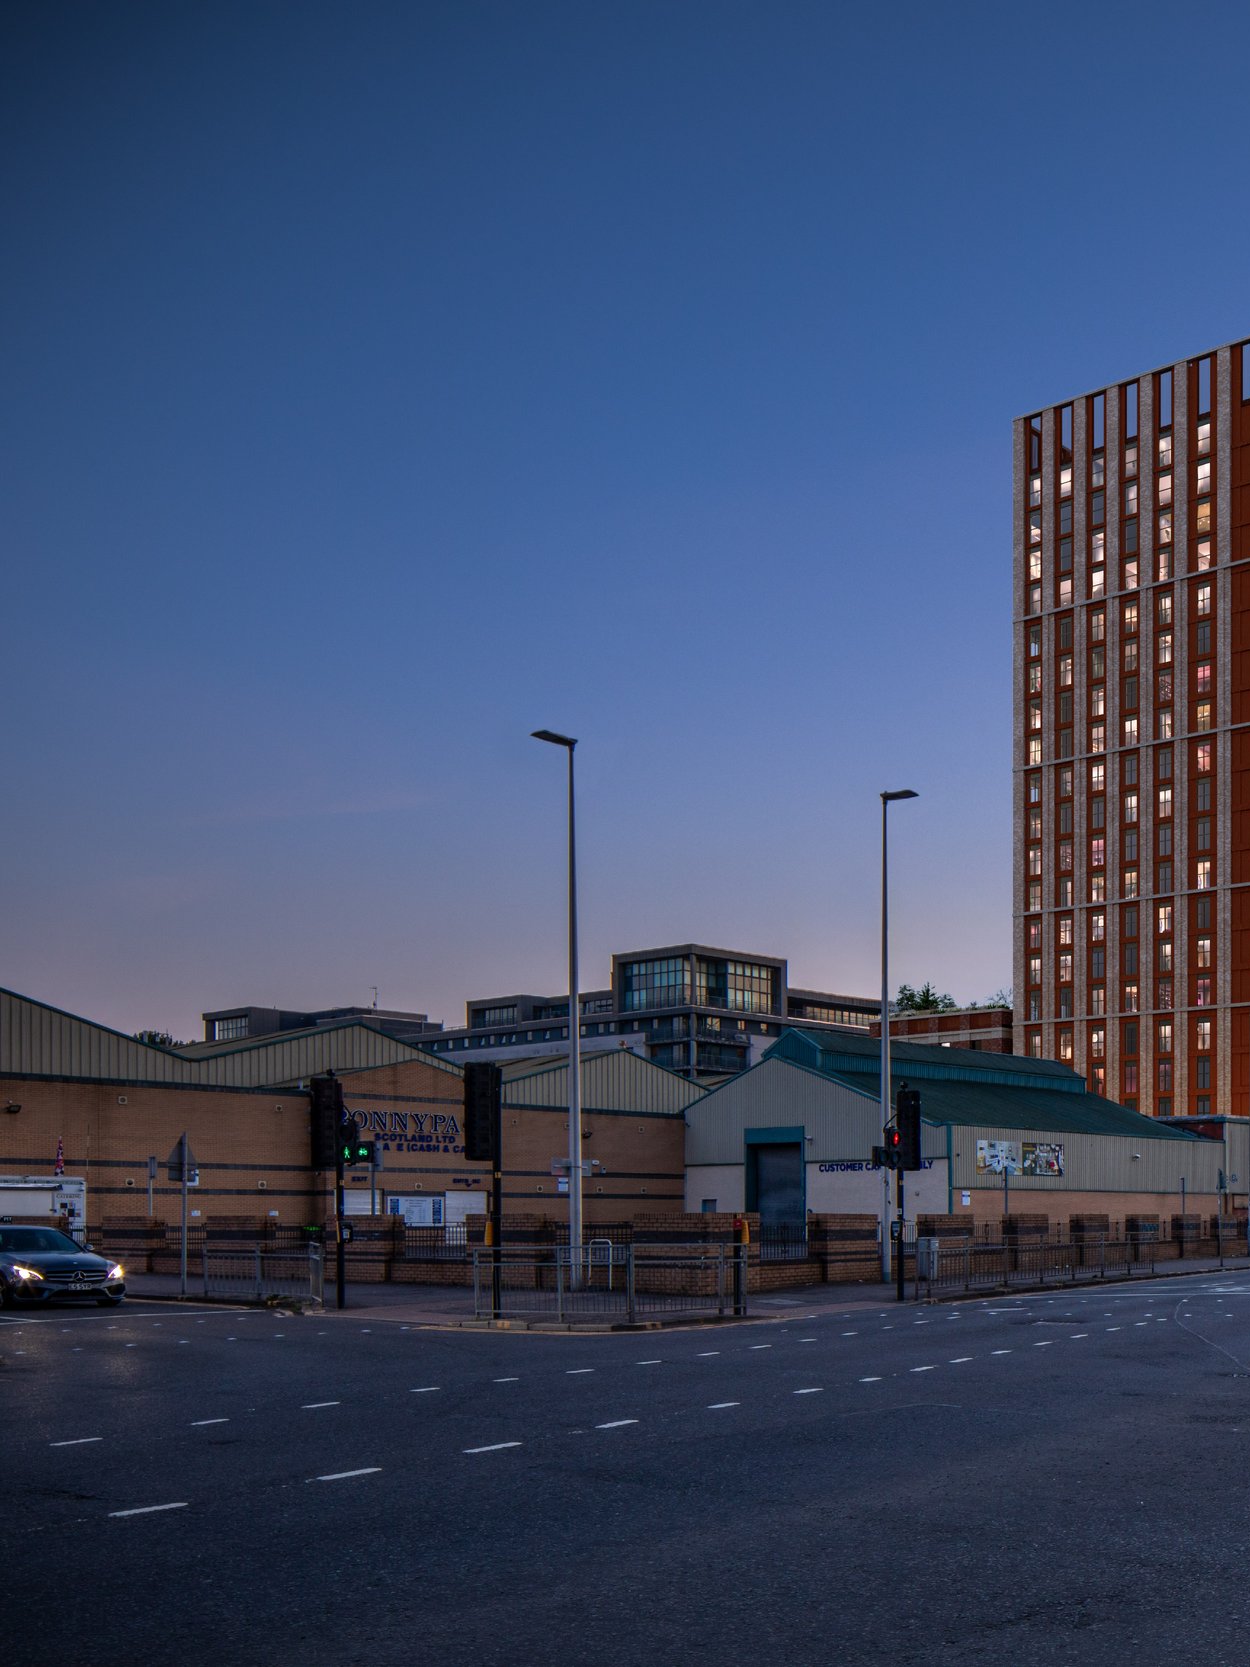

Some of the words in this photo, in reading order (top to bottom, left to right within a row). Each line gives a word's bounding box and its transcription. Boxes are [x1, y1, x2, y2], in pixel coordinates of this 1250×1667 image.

[374, 1132, 433, 1144] SCOTLAND
[436, 1136, 456, 1144] LTD
[407, 1143, 440, 1153] (CASH
[443, 1145, 450, 1153] &
[819, 1163, 863, 1172] CUSTOMER
